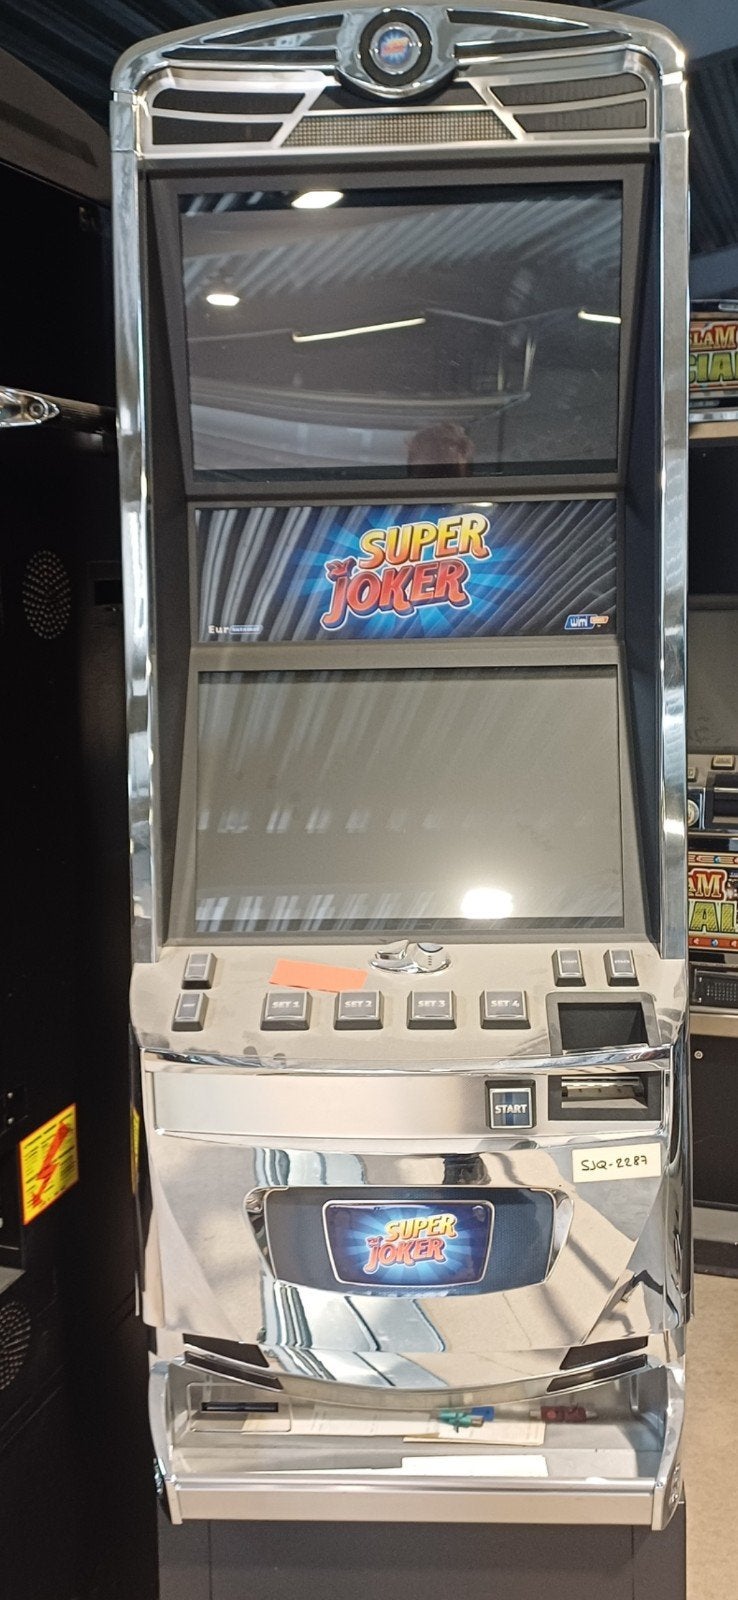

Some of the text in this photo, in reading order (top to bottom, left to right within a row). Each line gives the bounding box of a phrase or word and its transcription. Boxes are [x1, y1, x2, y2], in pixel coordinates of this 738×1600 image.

[359, 513, 491, 569] SUPER
[321, 555, 471, 630] JOKER
[272, 1000, 301, 1009] SET 1
[344, 1000, 372, 1008] SET 2
[417, 999, 446, 1008] SET 3
[490, 999, 520, 1008] SET 4
[495, 1103, 528, 1114] START
[581, 1155, 647, 1171] SJQ-2287
[385, 1214, 457, 1242] SUPER
[363, 1236, 447, 1274] JOKER
